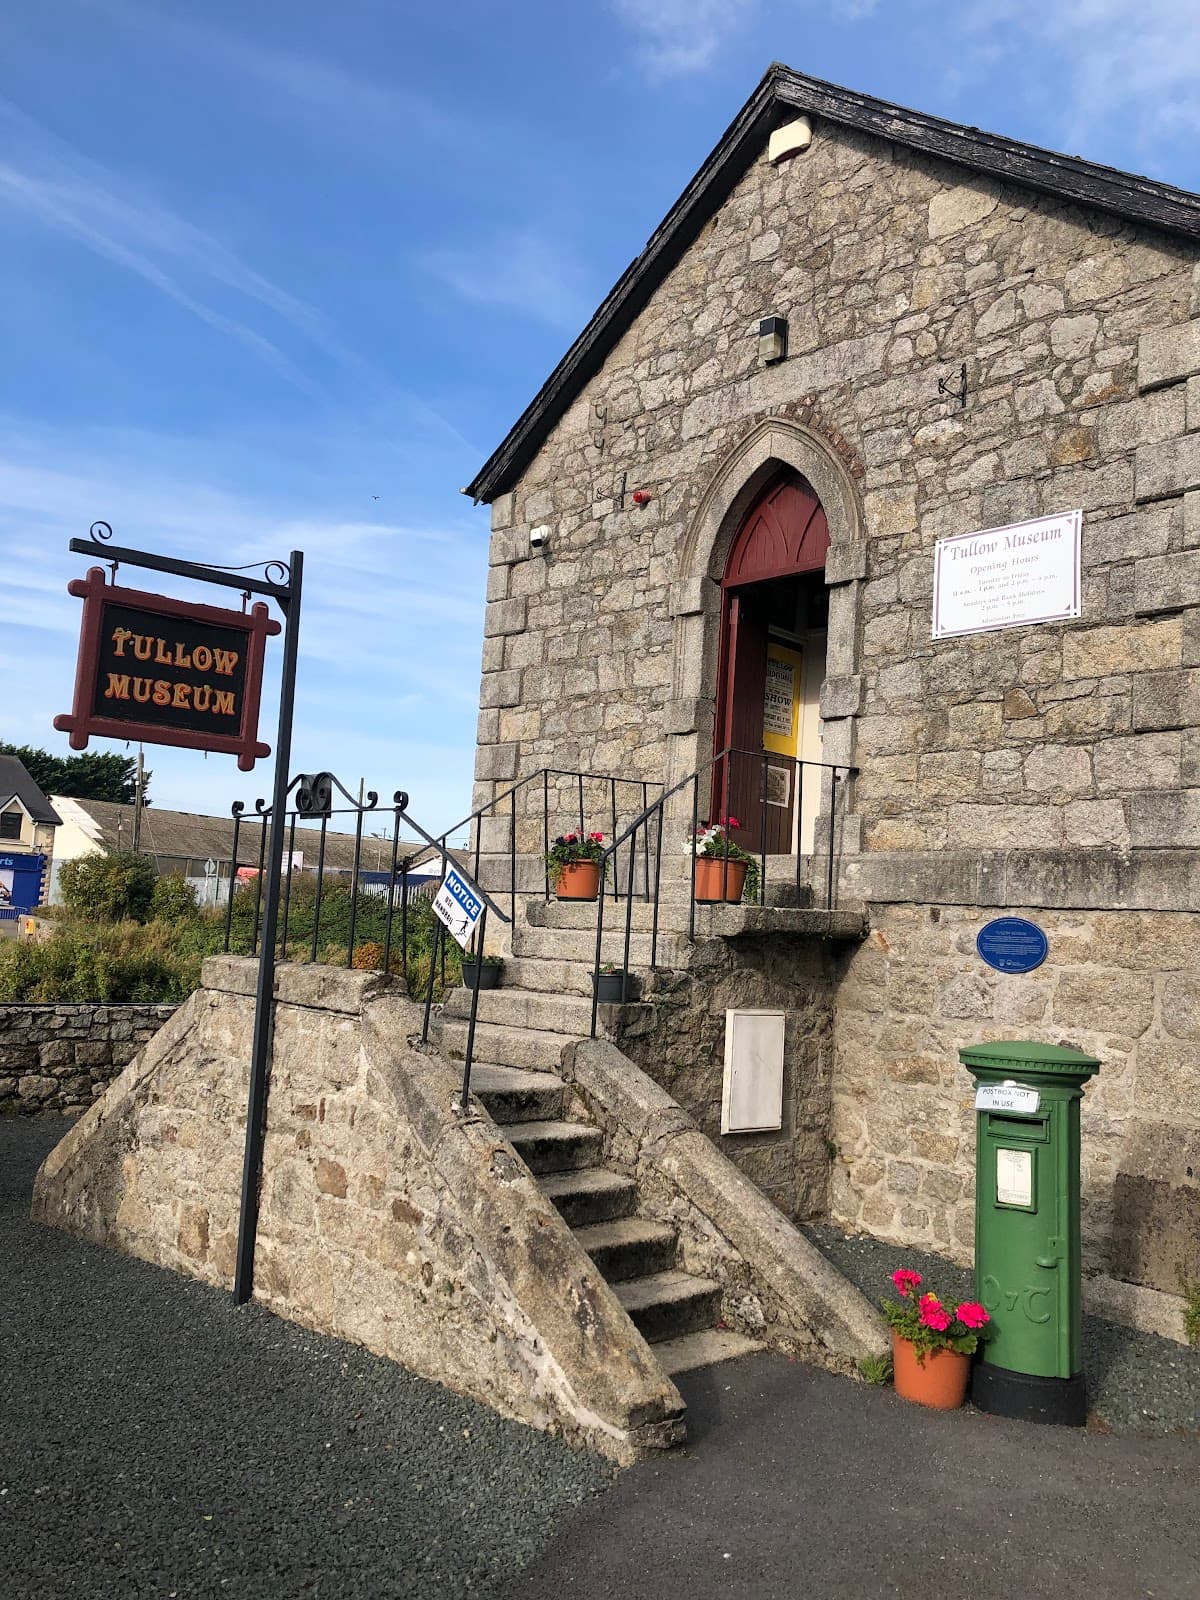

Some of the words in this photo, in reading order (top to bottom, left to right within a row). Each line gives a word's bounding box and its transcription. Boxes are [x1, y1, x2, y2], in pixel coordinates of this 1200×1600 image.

[950, 540, 998, 561] Tullow
[1003, 527, 1062, 551] Museum
[970, 561, 1008, 576] Opening
[1012, 554, 1039, 566] Hours
[112, 627, 239, 676] TULLOW
[104, 672, 236, 716] MUSEUM
[765, 692, 792, 707] SHOW
[444, 895, 454, 909] USE
[447, 875, 480, 917] NOTICE
[982, 1088, 1012, 1096] POSTBOX
